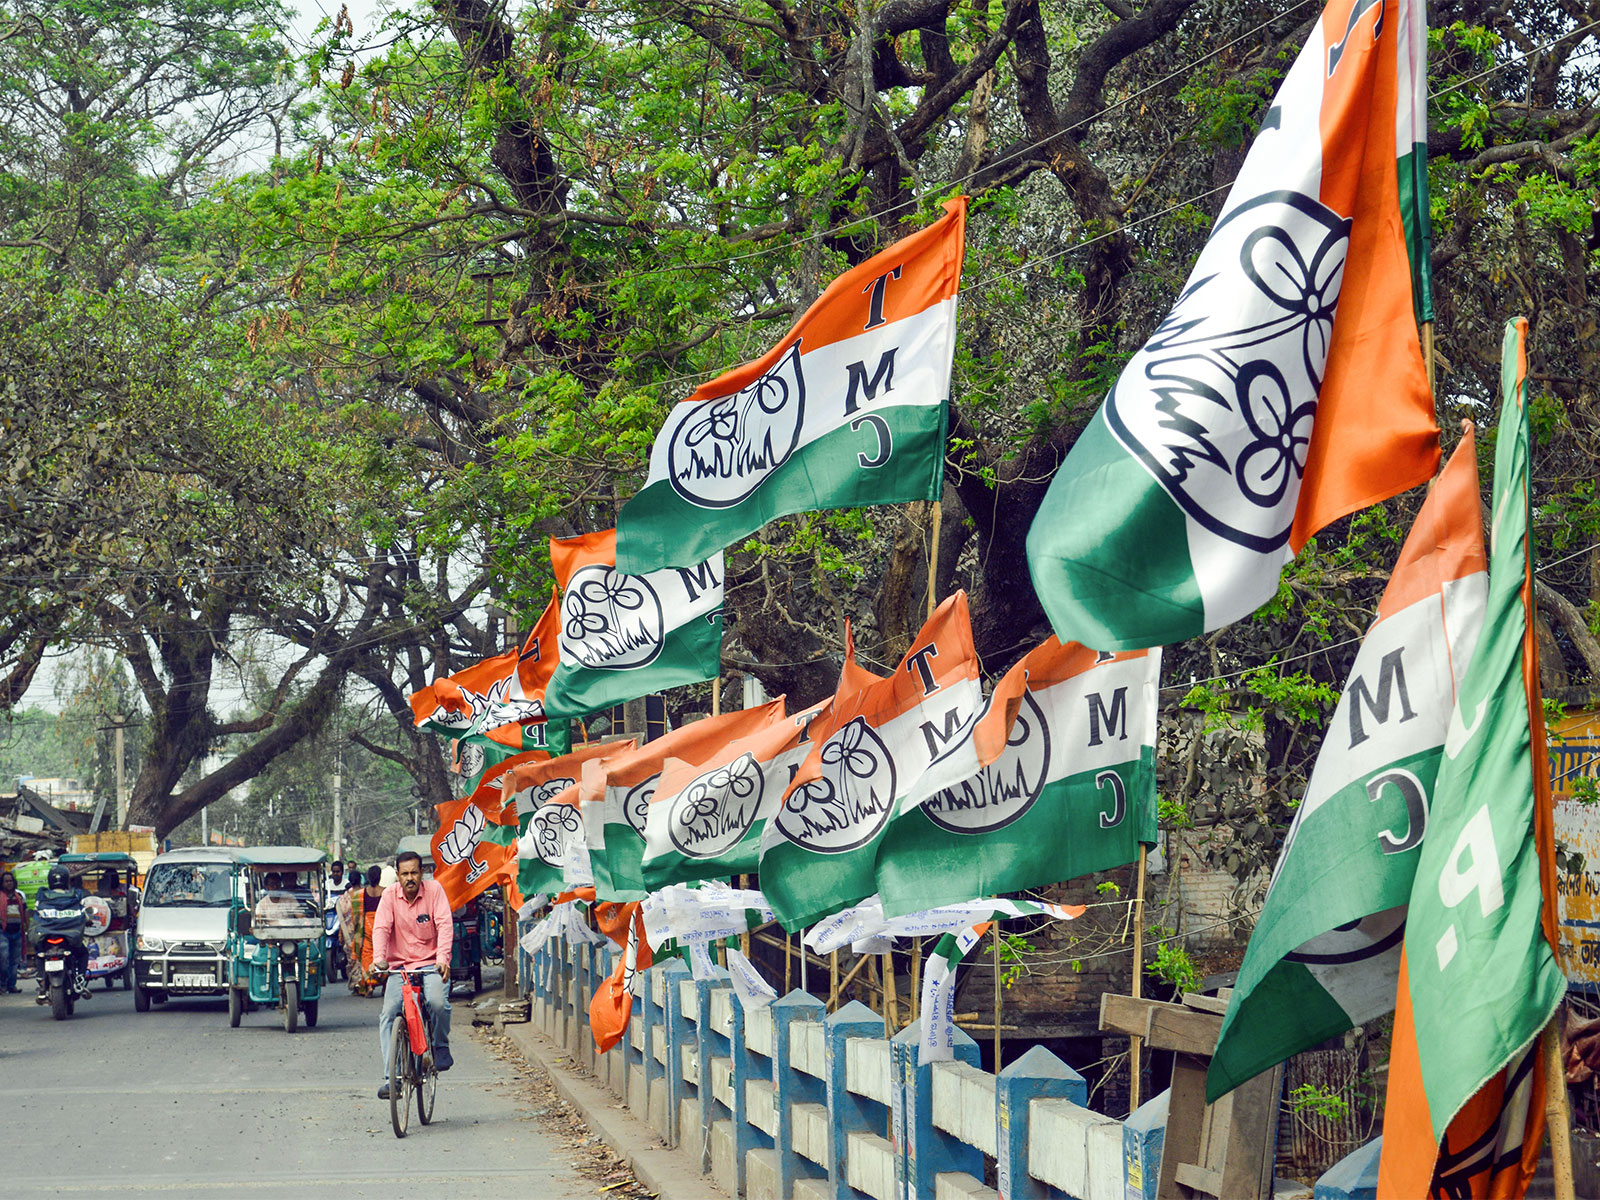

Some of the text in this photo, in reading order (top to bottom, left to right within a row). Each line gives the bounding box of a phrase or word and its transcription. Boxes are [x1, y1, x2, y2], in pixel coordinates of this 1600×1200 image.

[862, 264, 903, 330] T
[843, 346, 900, 417] M
[675, 559, 722, 603] M
[906, 642, 941, 697] T
[1347, 646, 1418, 751] M
[795, 708, 823, 744] T
[919, 706, 961, 762] M
[1084, 686, 1128, 747] M
